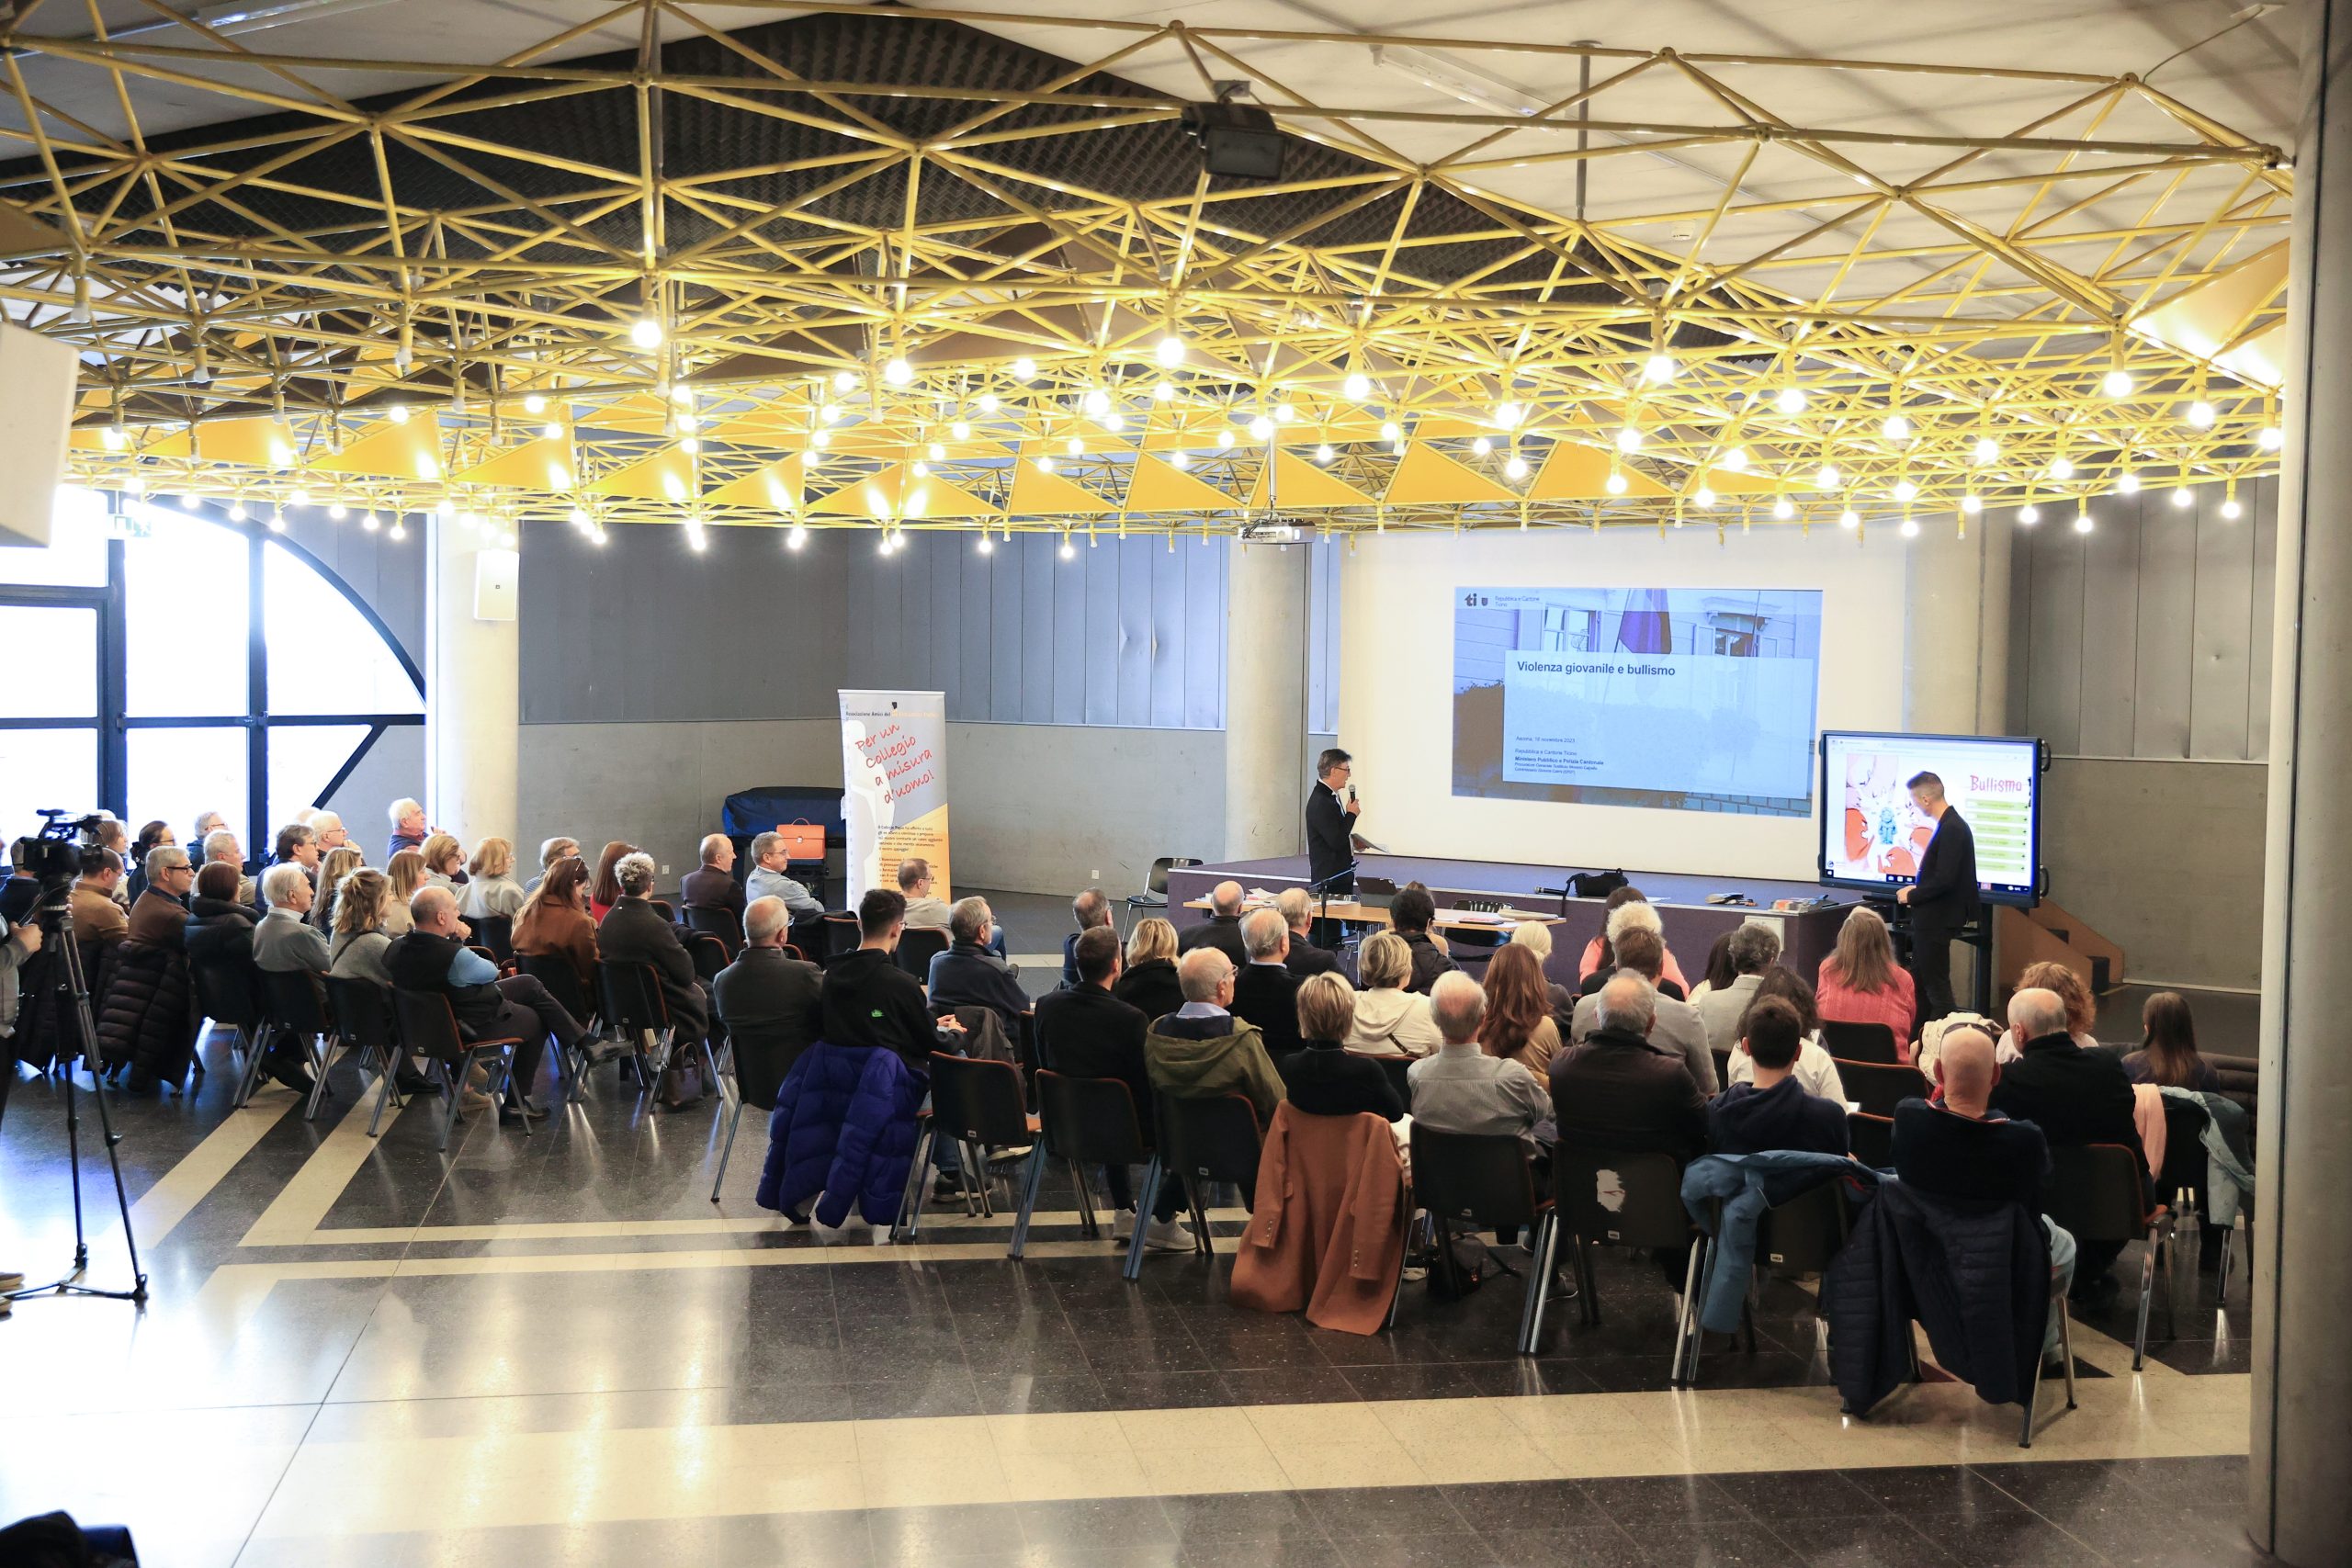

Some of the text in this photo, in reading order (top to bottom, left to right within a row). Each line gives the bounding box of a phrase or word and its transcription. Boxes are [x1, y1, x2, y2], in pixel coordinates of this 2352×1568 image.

[1517, 660, 1676, 676] Violenza giovanile e bullismo
[854, 724, 900, 751] Per un
[865, 735, 916, 768] Collegio
[875, 750, 933, 786] a misura
[884, 769, 934, 805] d'uomo!
[1969, 774, 2022, 793] Bullismo
